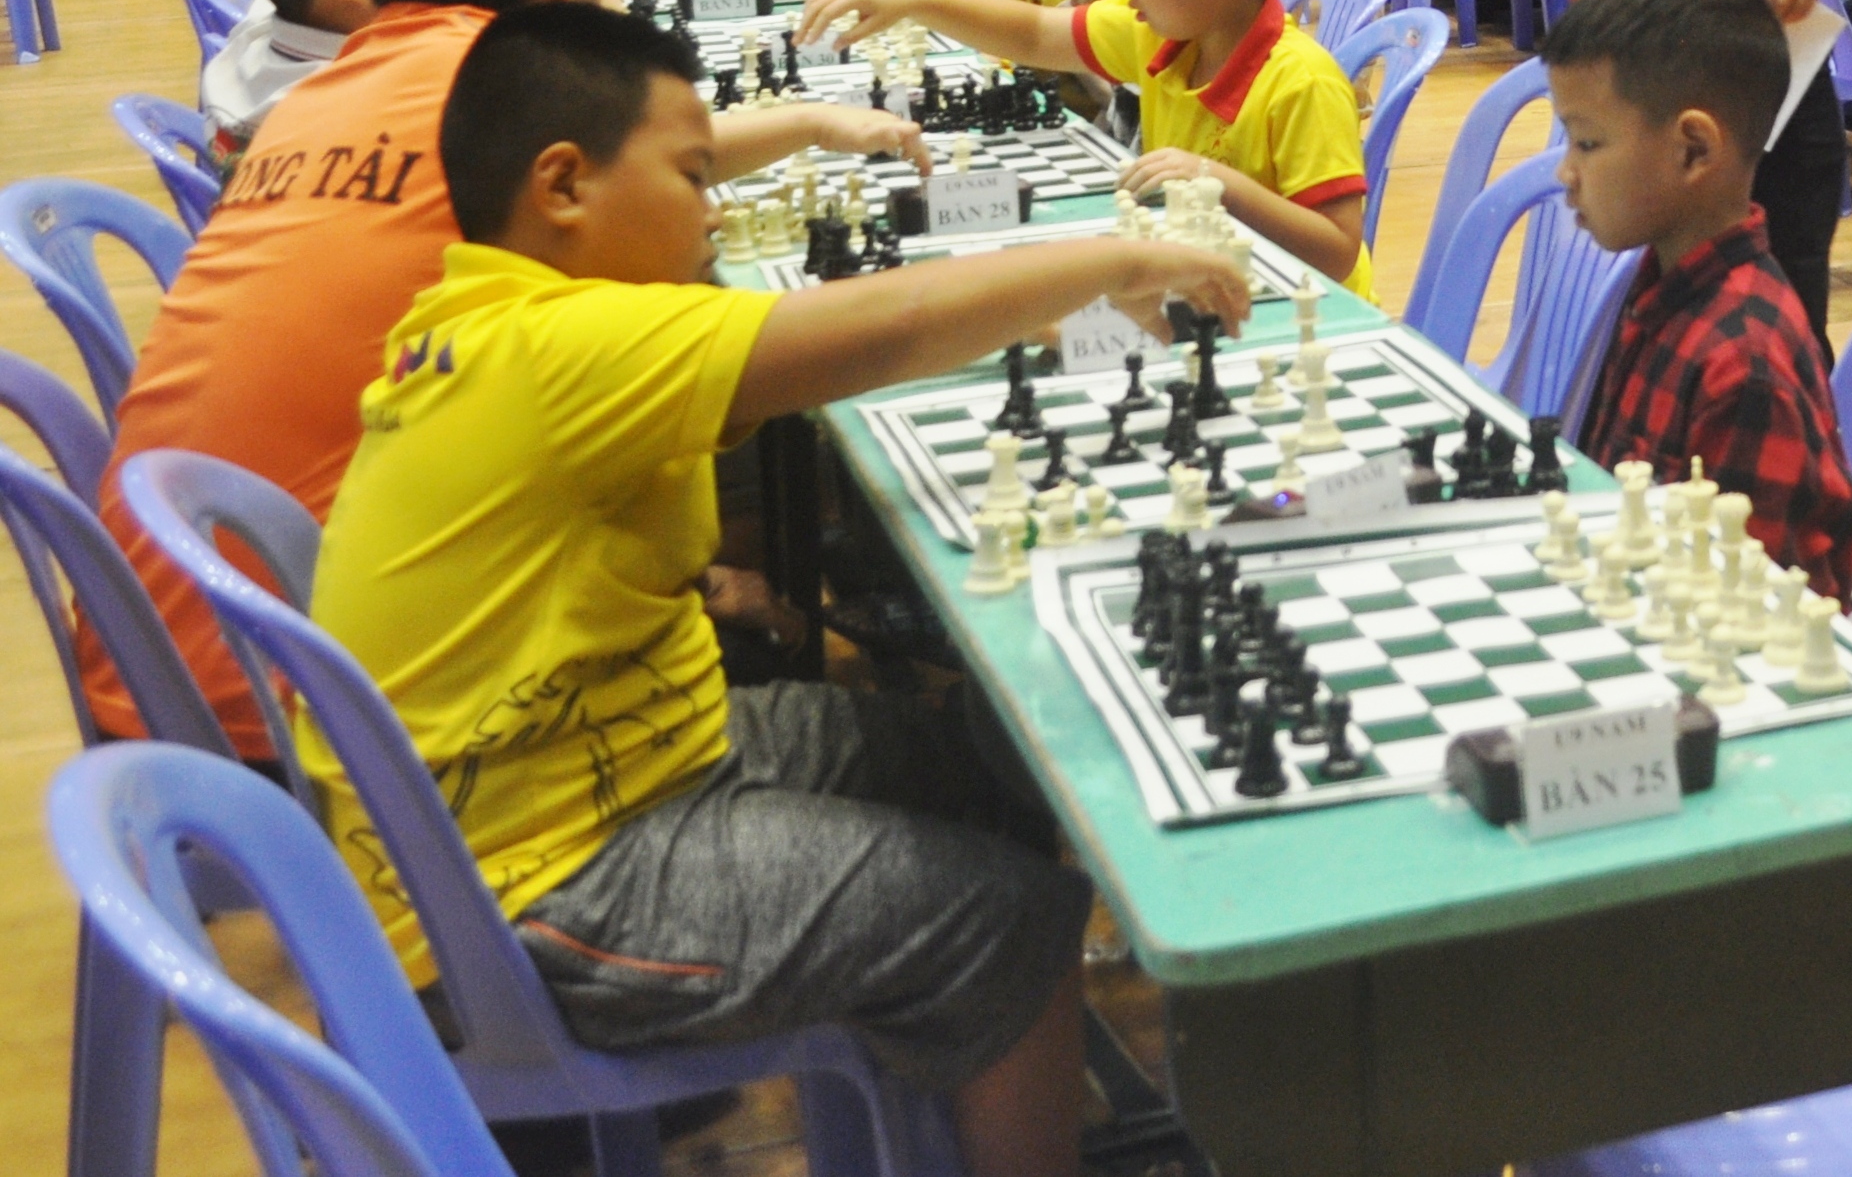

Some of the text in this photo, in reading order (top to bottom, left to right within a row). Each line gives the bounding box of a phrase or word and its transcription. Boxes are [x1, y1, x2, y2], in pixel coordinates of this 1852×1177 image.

[819, 53, 834, 66] 30
[308, 131, 424, 205] TÀI
[989, 200, 1010, 219] 28
[1592, 712, 1646, 737] NAM
[1632, 760, 1667, 796] 25
